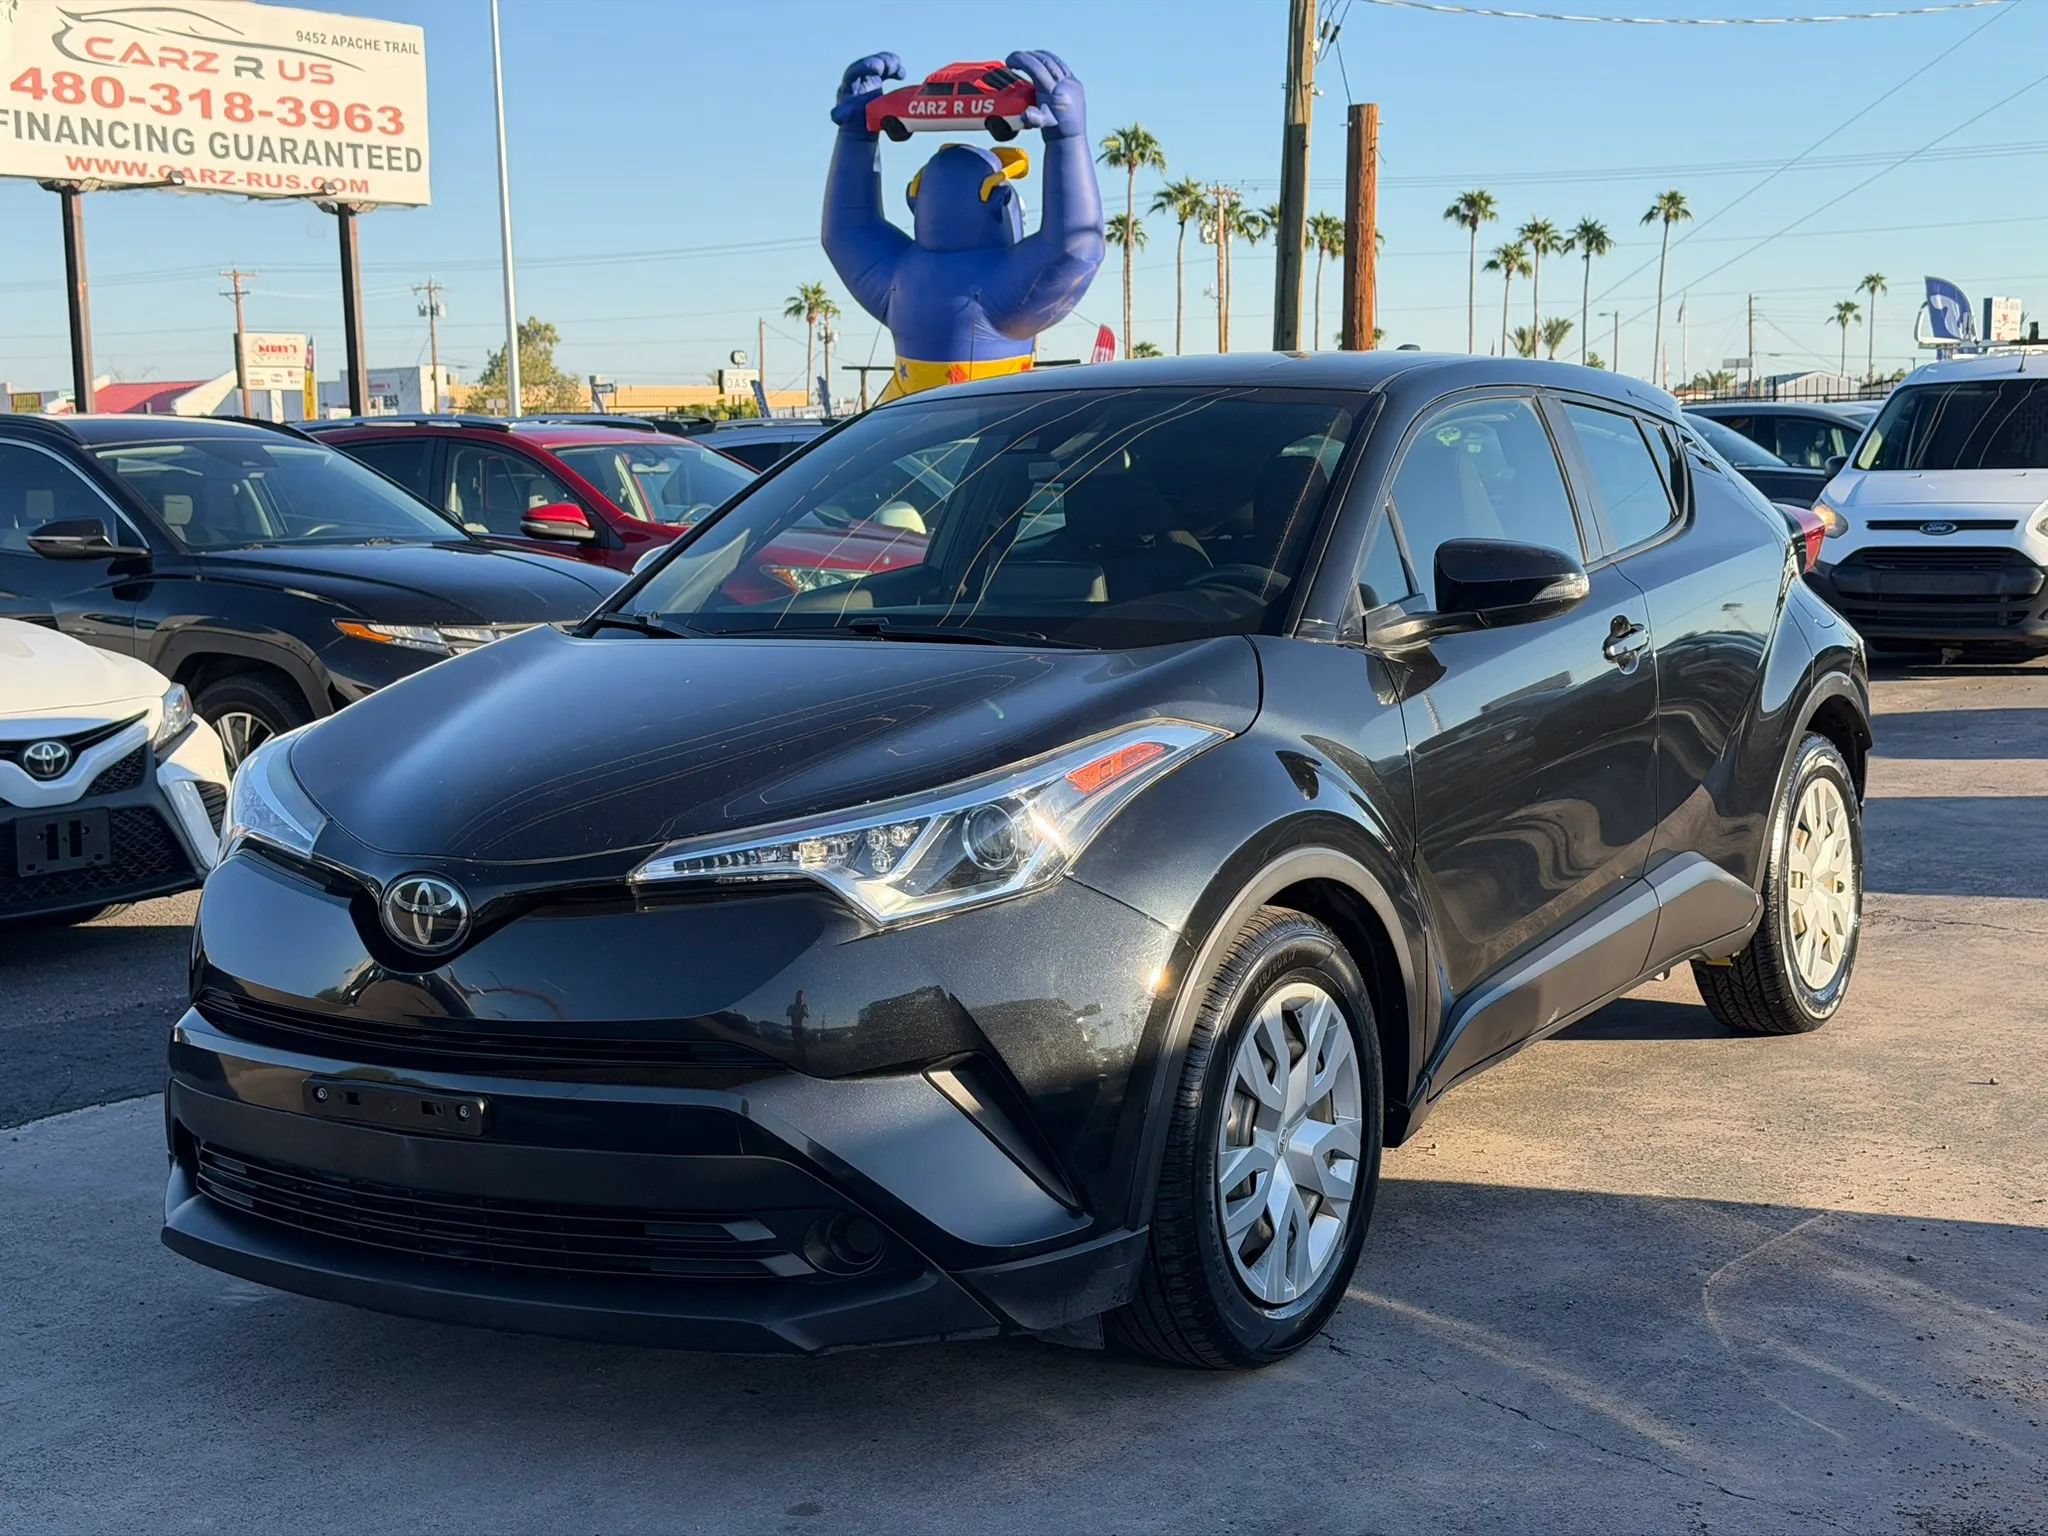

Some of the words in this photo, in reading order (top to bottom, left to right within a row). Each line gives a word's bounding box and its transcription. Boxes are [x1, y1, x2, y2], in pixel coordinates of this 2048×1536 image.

[84, 37, 220, 74] CARZ
[233, 55, 265, 80] R
[278, 59, 335, 86] US
[296, 30, 328, 45] 9452
[331, 35, 381, 52] APACHE
[384, 40, 420, 55] TRAIL
[10, 66, 405, 137] 480-318-3963
[908, 100, 947, 115] CARZ
[953, 100, 964, 114] R
[971, 99, 995, 114] US
[208, 131, 422, 173] GUARANTEED
[65, 155, 370, 194] WWW.CARZ-RUS.COM
